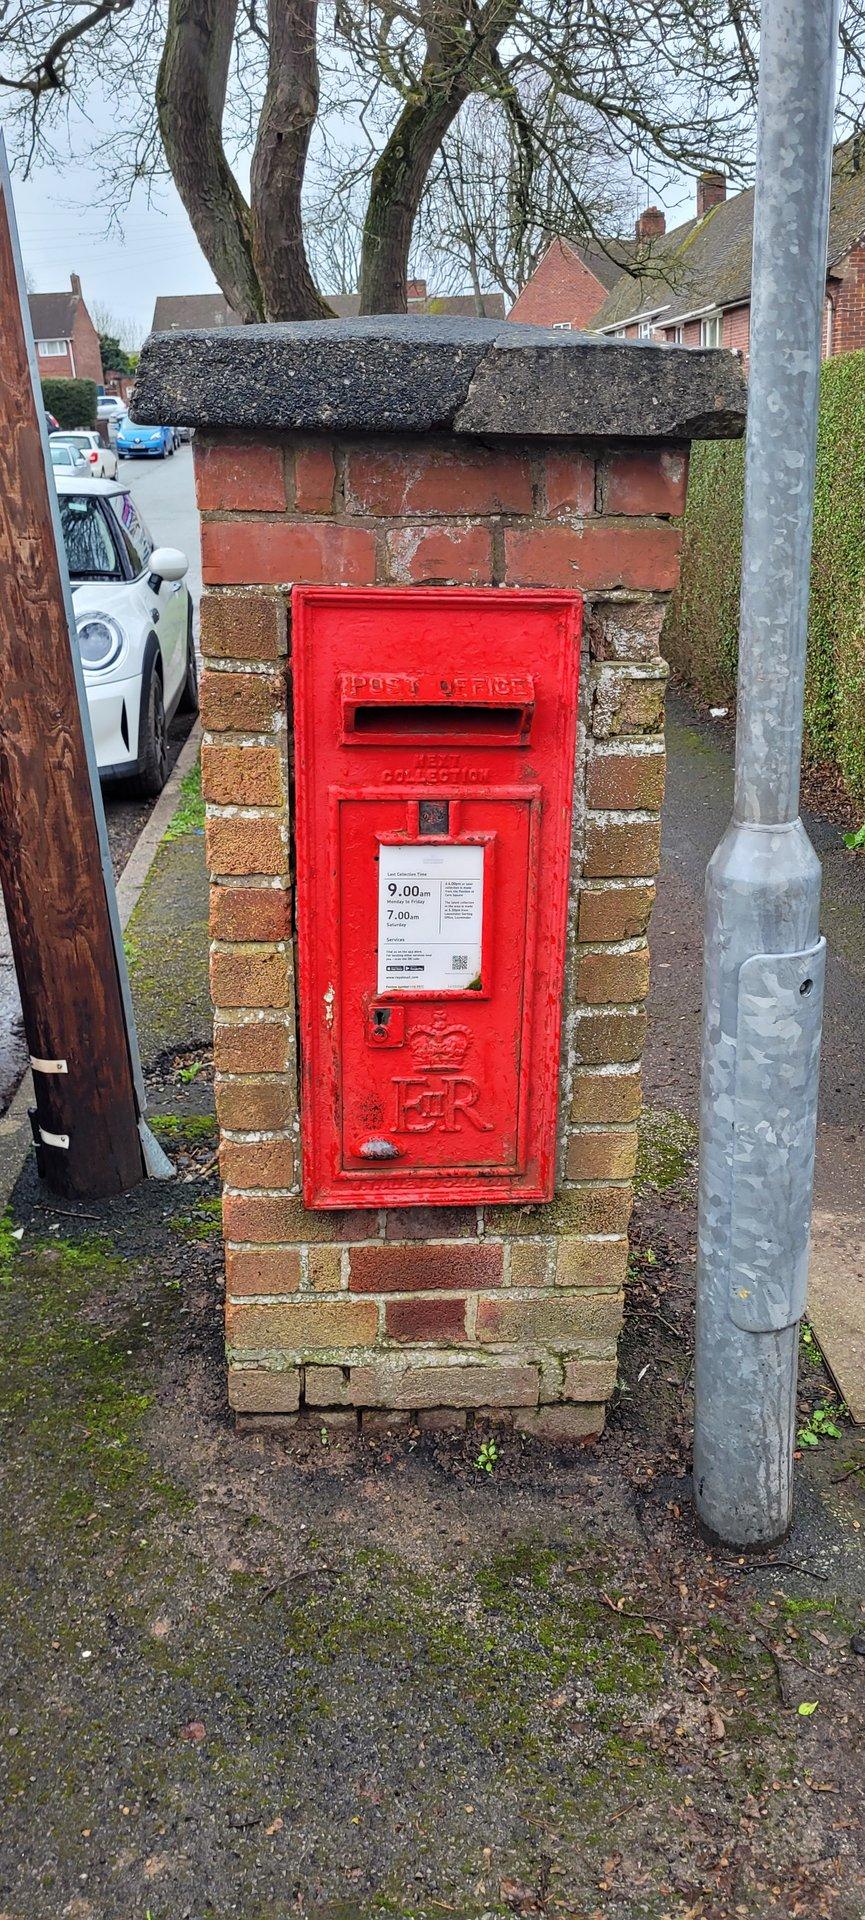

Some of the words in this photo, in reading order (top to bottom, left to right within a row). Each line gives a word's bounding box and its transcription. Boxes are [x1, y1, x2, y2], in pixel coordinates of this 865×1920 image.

[350, 676, 419, 697] POST
[440, 677, 528, 697] OFFICE
[415, 754, 461, 769] NEXT
[381, 768, 491, 784] COLLECTION
[387, 882, 431, 897] 9.00am
[387, 909, 420, 920] 7.00am
